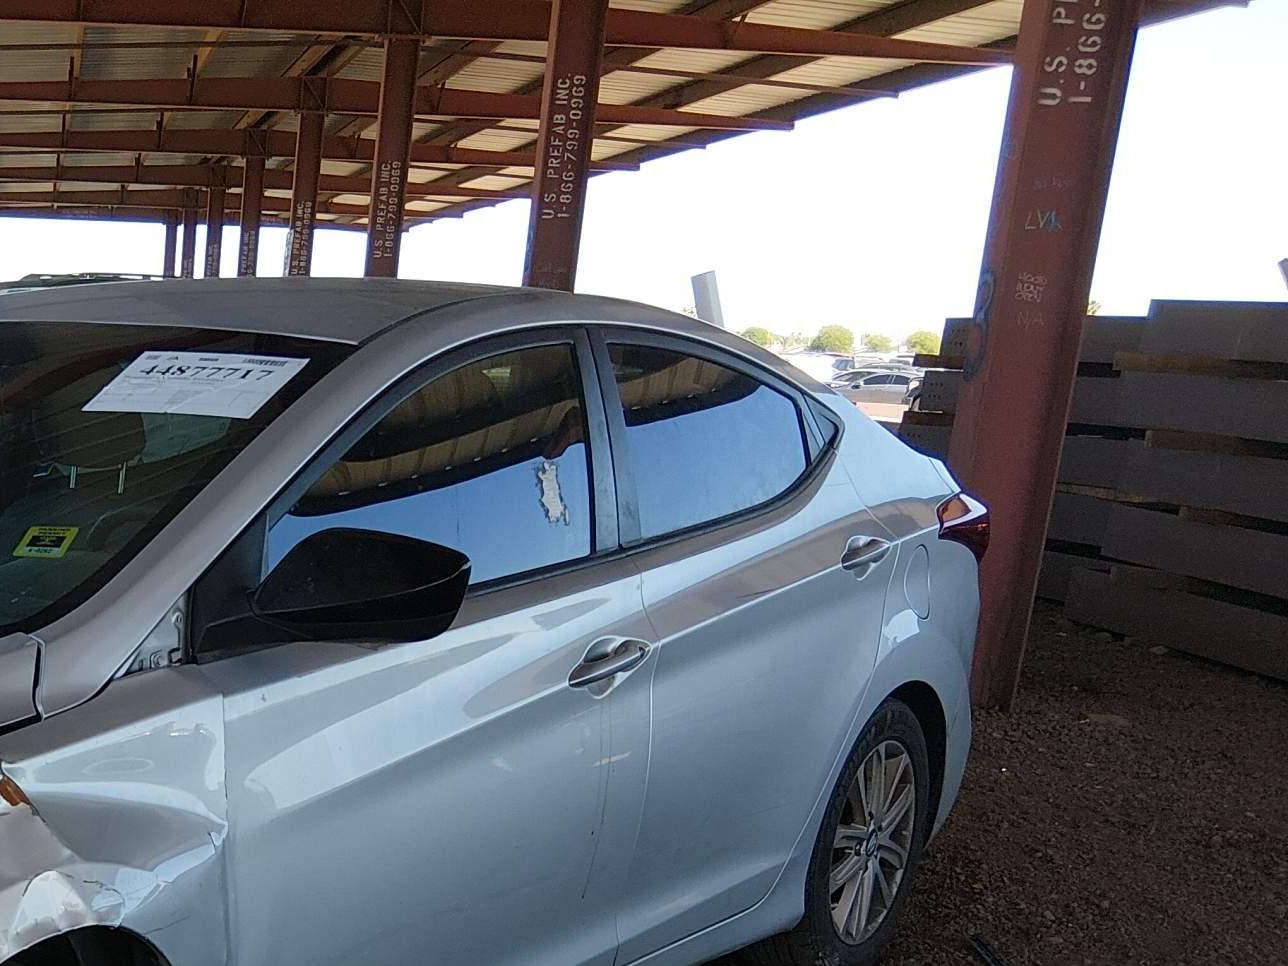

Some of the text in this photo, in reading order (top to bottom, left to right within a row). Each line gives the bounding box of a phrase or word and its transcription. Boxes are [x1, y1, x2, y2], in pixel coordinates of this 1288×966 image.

[1037, 0, 1079, 106] U.S. P
[554, 73, 572, 105] INC.
[546, 113, 567, 178] PREFAB
[557, 74, 587, 218] 1-866-799-0969
[380, 160, 392, 182] INC.
[376, 187, 389, 231] PREFAB
[139, 363, 275, 382] 44877717
